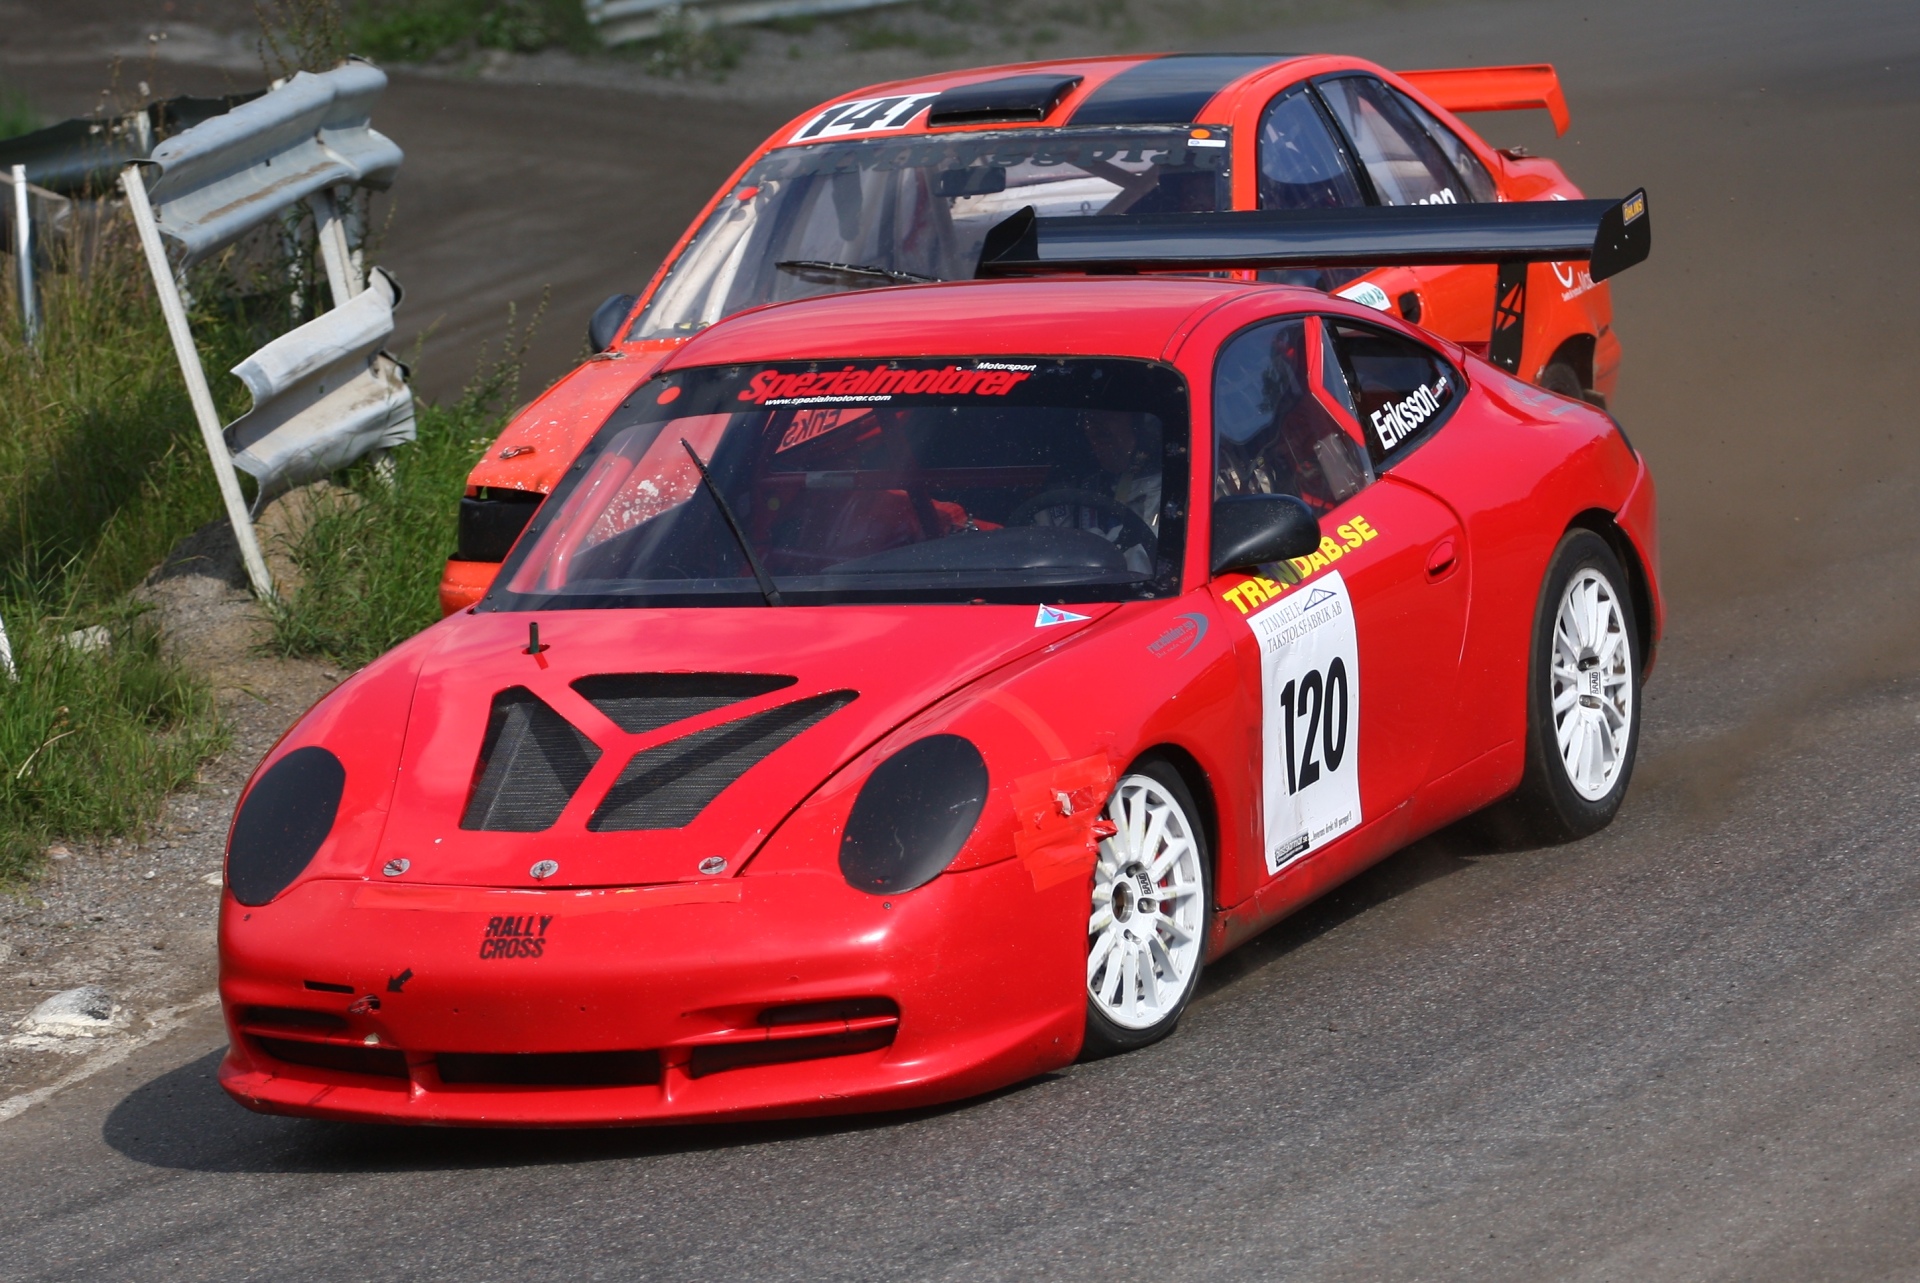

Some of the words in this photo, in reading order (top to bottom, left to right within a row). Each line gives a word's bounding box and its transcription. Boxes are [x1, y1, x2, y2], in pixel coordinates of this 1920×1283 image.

[800, 94, 939, 139] 141
[976, 361, 1037, 372] Motorsport
[737, 364, 1031, 405] Spezialmotorer
[764, 393, 892, 406] www.spezialmotorer.com
[1370, 383, 1440, 450] Eriksson
[1259, 601, 1304, 636] TIMMELE
[1331, 600, 1343, 618] AB
[1280, 656, 1348, 796] 120
[485, 916, 554, 937] RALLY
[479, 937, 546, 959] CROSS
